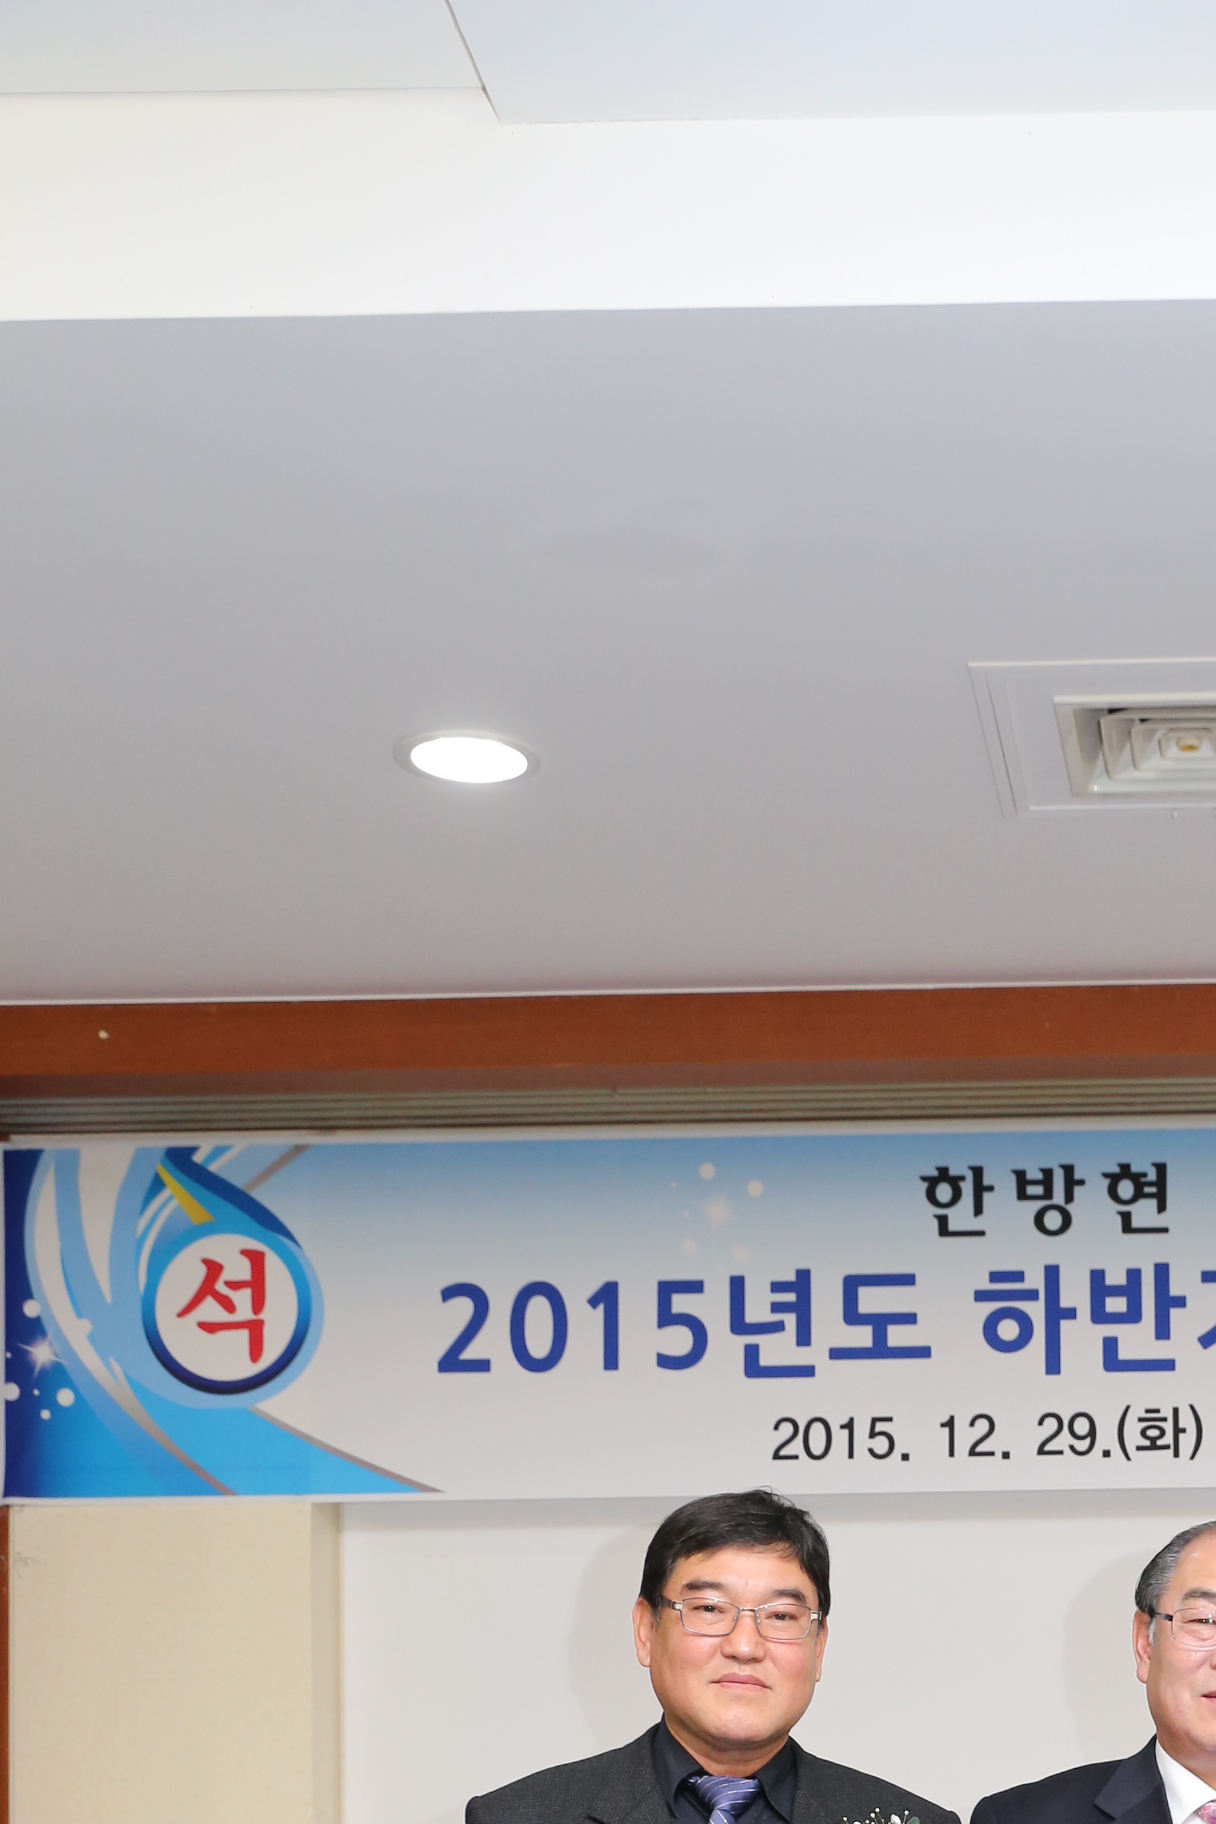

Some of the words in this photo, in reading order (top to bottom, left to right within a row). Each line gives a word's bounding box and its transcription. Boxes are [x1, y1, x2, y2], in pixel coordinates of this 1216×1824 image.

[918, 1161, 1170, 1238] 한방현
[176, 1248, 266, 1364] 석
[438, 1268, 932, 1379] 2015년도
[772, 1416, 910, 1462] 2015.
[940, 1413, 1011, 1460] 12.
[1036, 1404, 1203, 1462] 29.(화)
